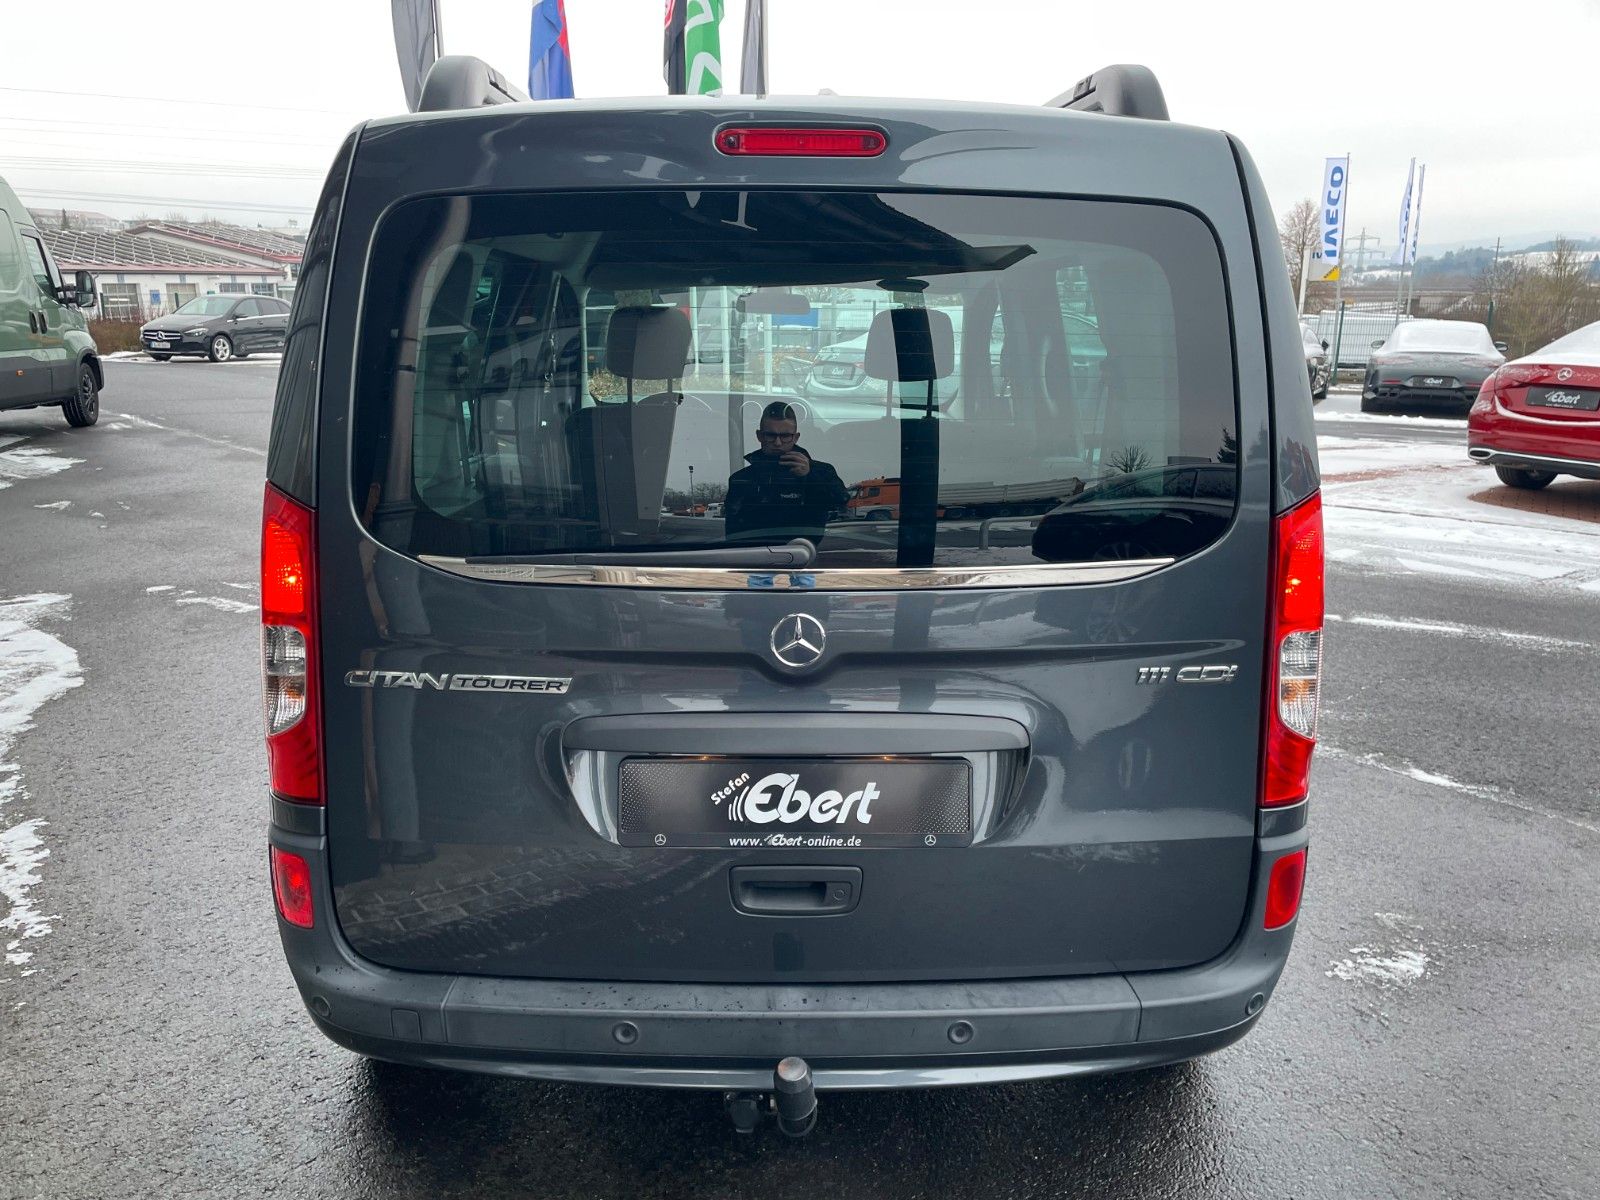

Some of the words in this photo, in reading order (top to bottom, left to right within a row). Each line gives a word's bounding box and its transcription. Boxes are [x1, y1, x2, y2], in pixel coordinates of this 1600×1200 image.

[1551, 391, 1580, 404] Ebert
[344, 670, 449, 691] CITAN
[456, 677, 564, 692] TOURER
[710, 771, 750, 805] Stefan
[744, 772, 881, 824] Ebert
[729, 833, 862, 847] www.Ebert-online.de
